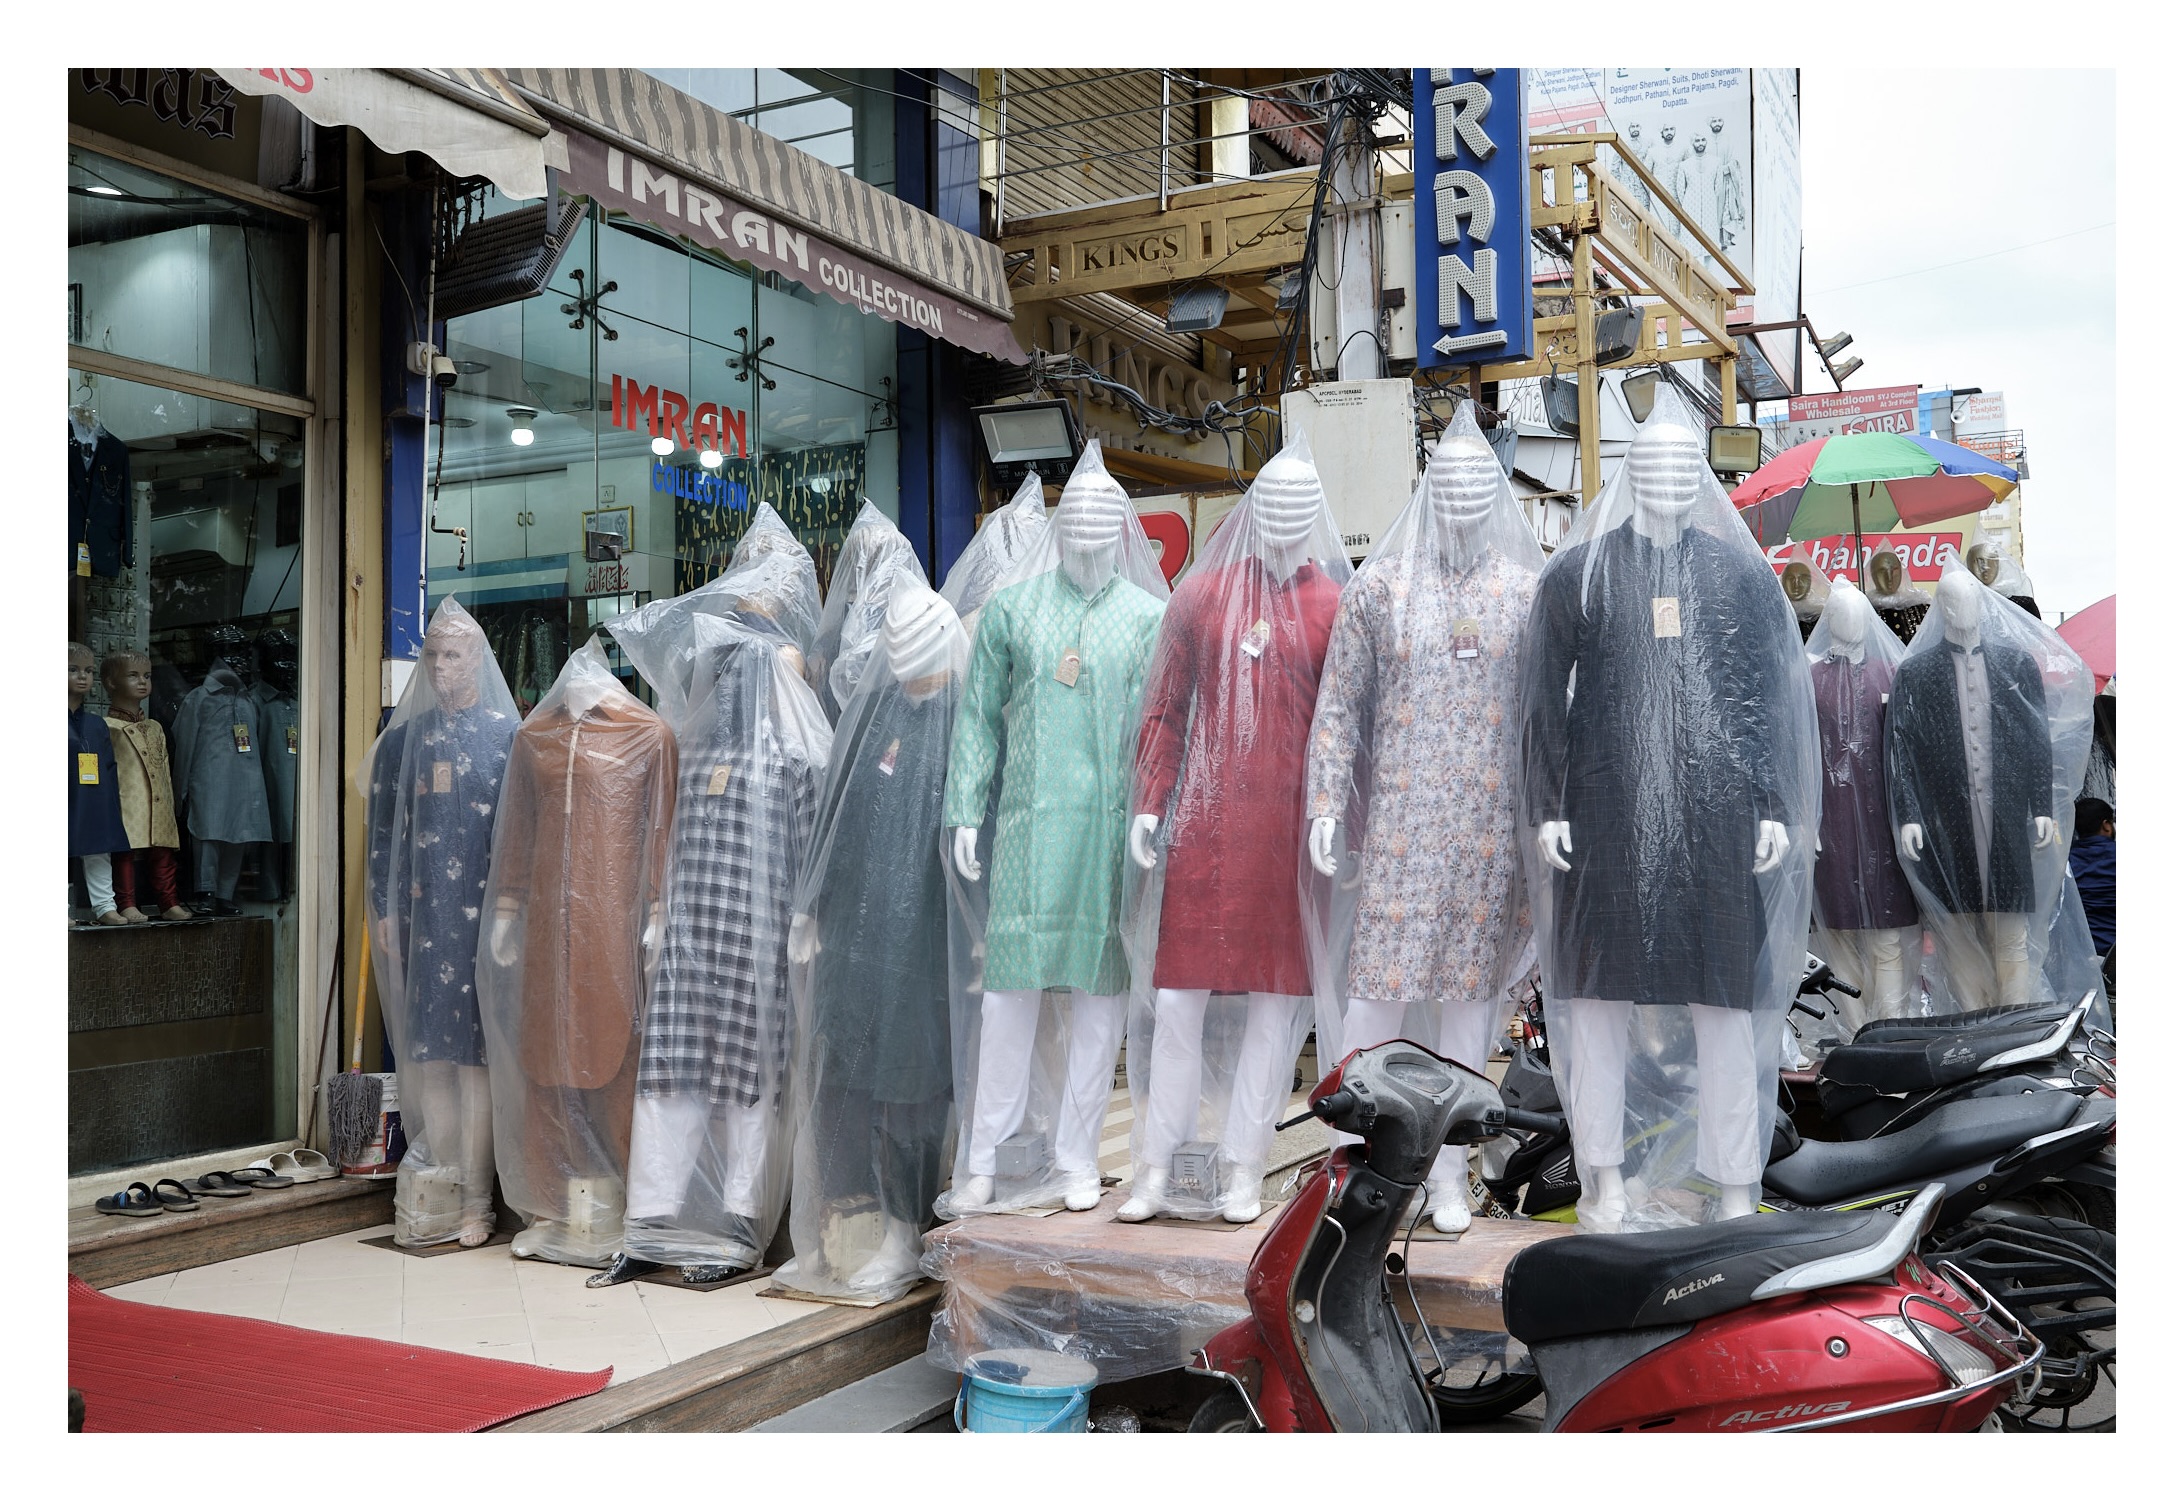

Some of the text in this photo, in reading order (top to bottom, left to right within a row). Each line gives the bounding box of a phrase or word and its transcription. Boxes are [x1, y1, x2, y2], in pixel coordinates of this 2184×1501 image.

[1610, 68, 1743, 95] Designer Sherwani, Suits, Dhoti Sherwani,
[1613, 93, 1644, 105] Jodhpuri,
[1645, 88, 1671, 100] Pathani,
[1672, 86, 1690, 96] Kurta
[1691, 82, 1717, 93] Pajama,
[1718, 78, 1739, 90] Pagdi,
[1431, 68, 1498, 327] RAN
[606, 146, 944, 333] IMRAN COLLECTION
[1084, 233, 1179, 271] KINGS
[1049, 315, 1211, 443] KINGS
[1791, 393, 1875, 411] Saira Handloom
[1890, 390, 1917, 400] Complex
[1899, 398, 1915, 406] Floor
[612, 373, 747, 460] IMRAN
[1805, 406, 1861, 420] Wholesale
[652, 461, 748, 512] COLLECTION
[1545, 1180, 1581, 1190] HONDA
[1663, 1273, 1725, 1305] Activa
[1719, 1400, 1852, 1426] Activa
